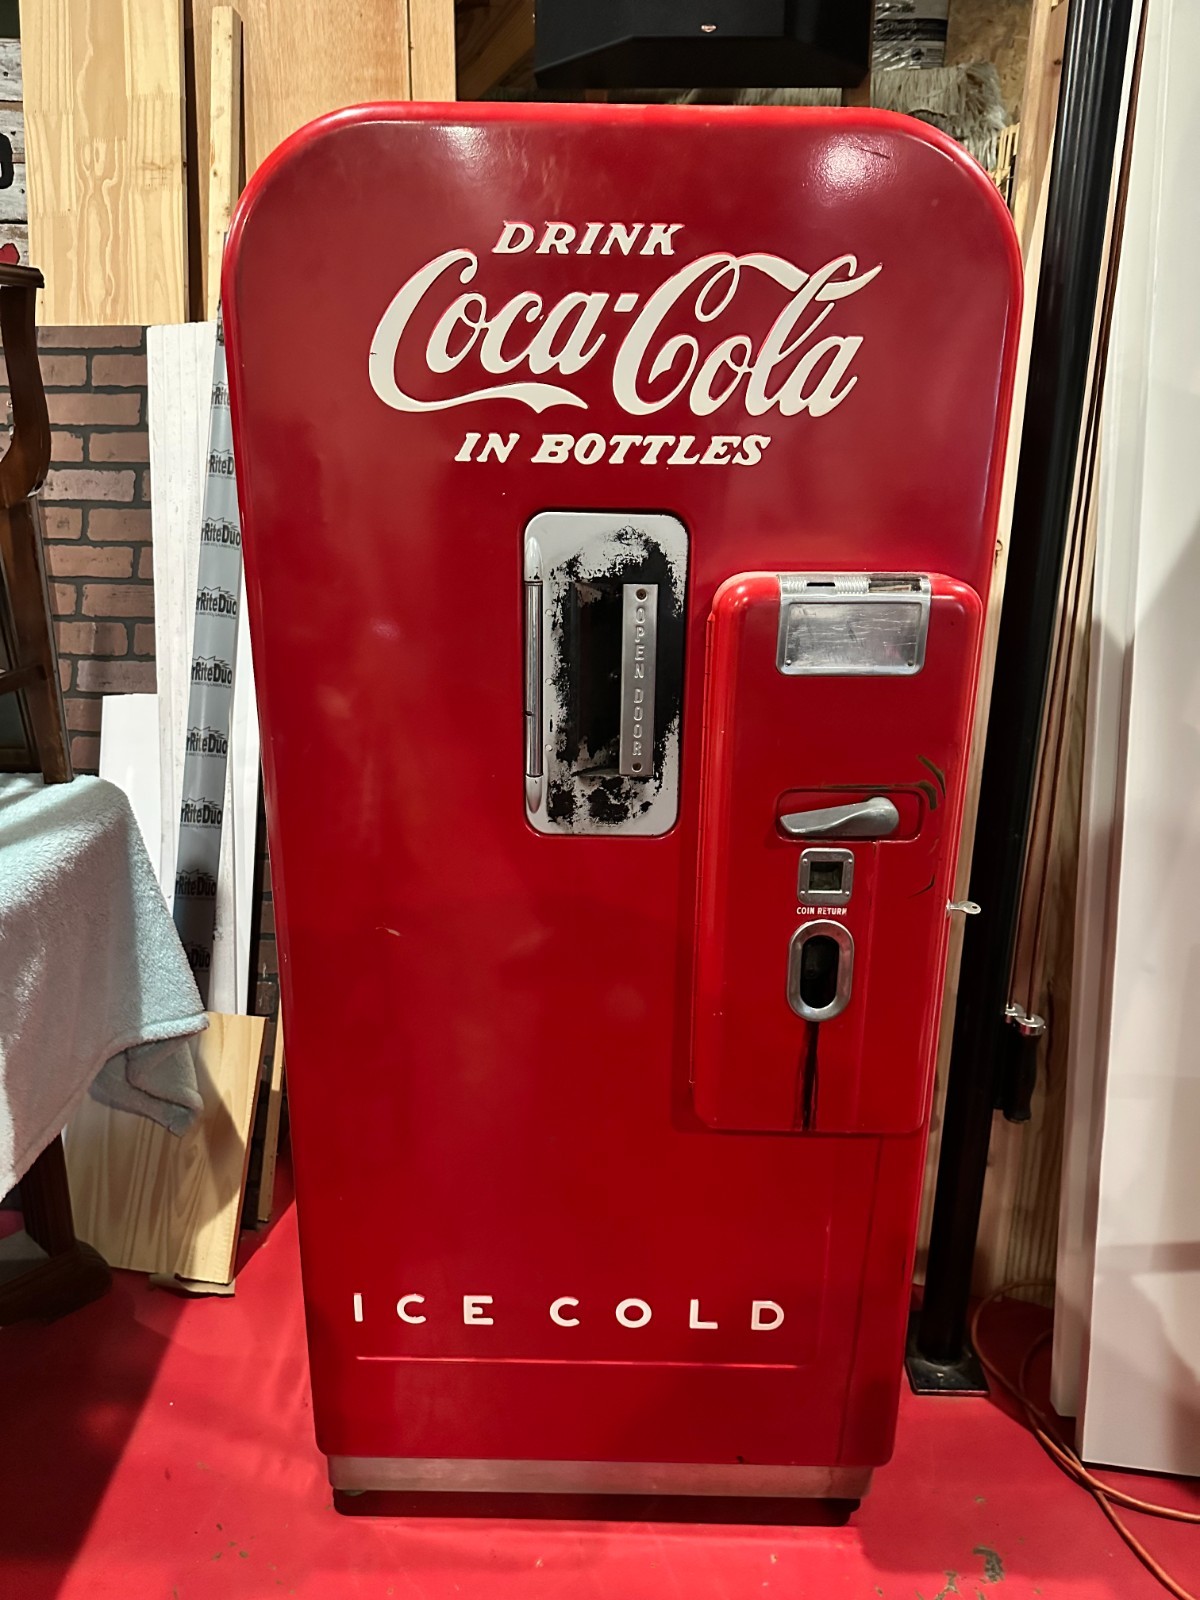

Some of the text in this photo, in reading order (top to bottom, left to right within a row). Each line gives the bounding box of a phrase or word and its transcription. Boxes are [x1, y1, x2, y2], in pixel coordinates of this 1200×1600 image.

[491, 220, 684, 255] DRINK
[368, 248, 883, 417] Coca-Cola
[454, 432, 772, 466] IN BOTTLES
[632, 606, 646, 756] OPEN DOOR
[796, 906, 848, 916] COIN RETURN
[353, 1292, 785, 1331] ICE COLD
